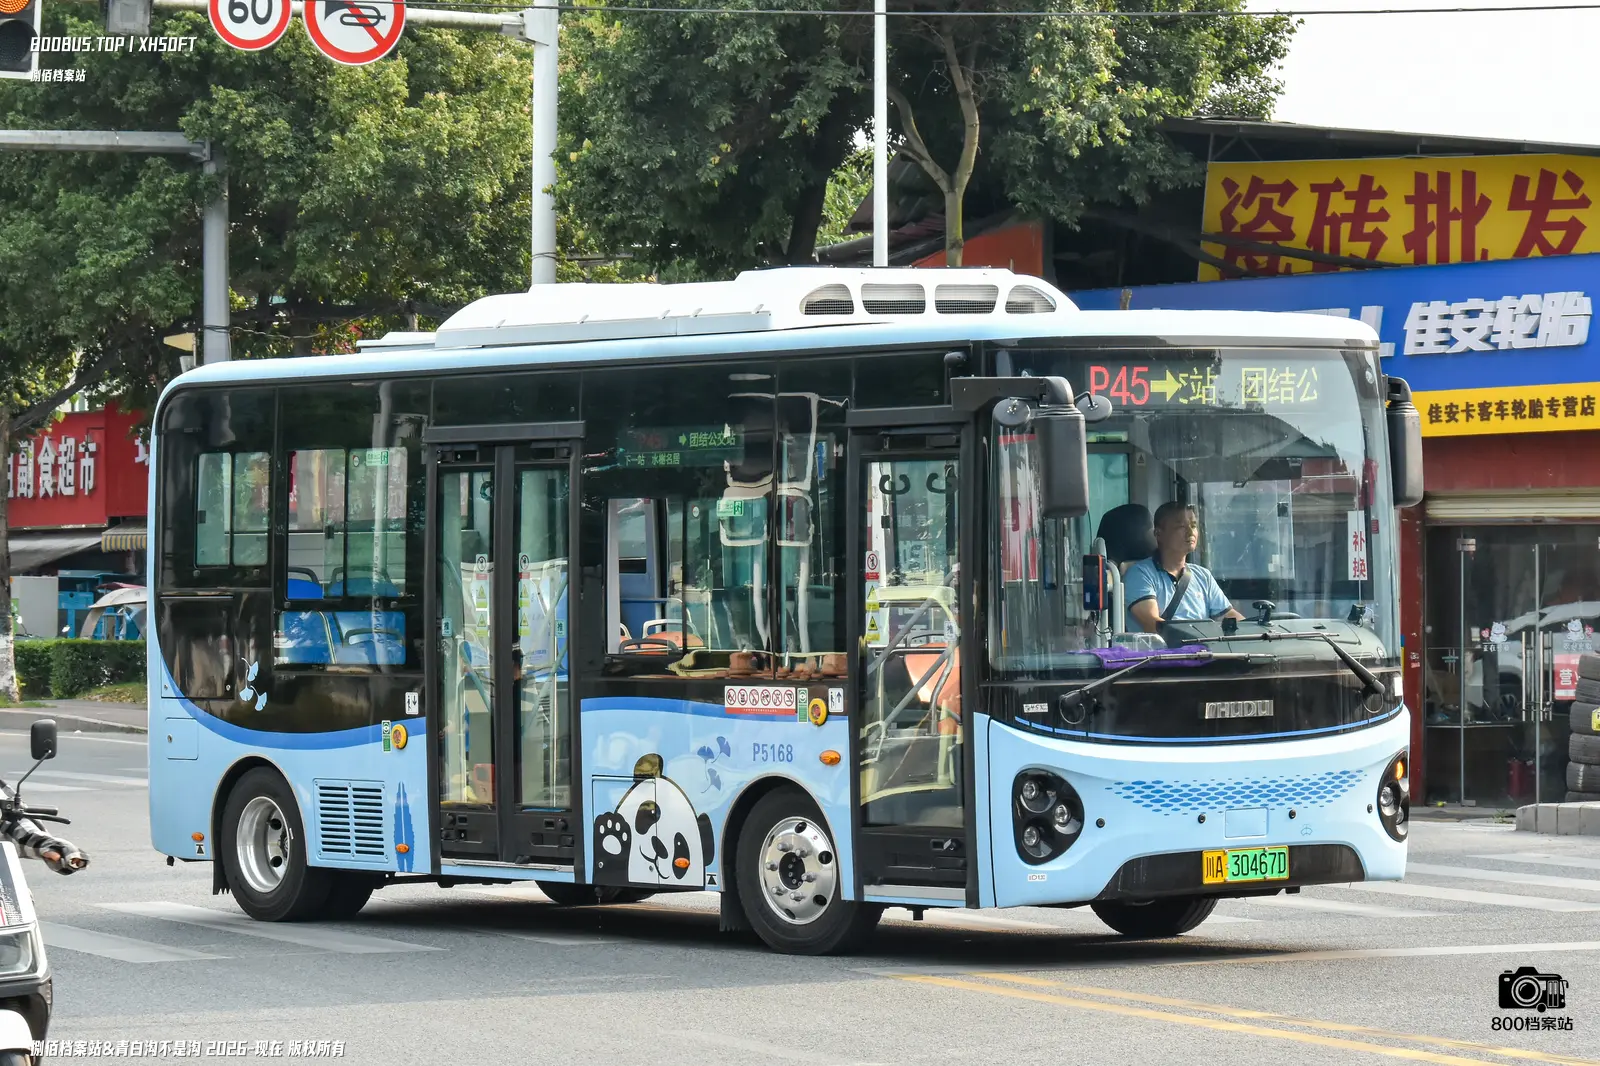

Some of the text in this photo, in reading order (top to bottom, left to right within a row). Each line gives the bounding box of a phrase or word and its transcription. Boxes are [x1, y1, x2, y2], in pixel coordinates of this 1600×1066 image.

[228, 0, 273, 25] 60
[1219, 168, 1592, 279] 瓷砖批发
[1403, 291, 1593, 355] 佳安轮胎
[1089, 365, 1150, 406] P45
[1241, 366, 1318, 405] 团结公
[1427, 395, 1596, 424] 佳安卡客车轮胎专营店
[8, 435, 97, 499] 副食超市
[624, 454, 646, 466] 下一站
[752, 743, 793, 763] P5168
[1206, 851, 1287, 878] 川A 30467D
